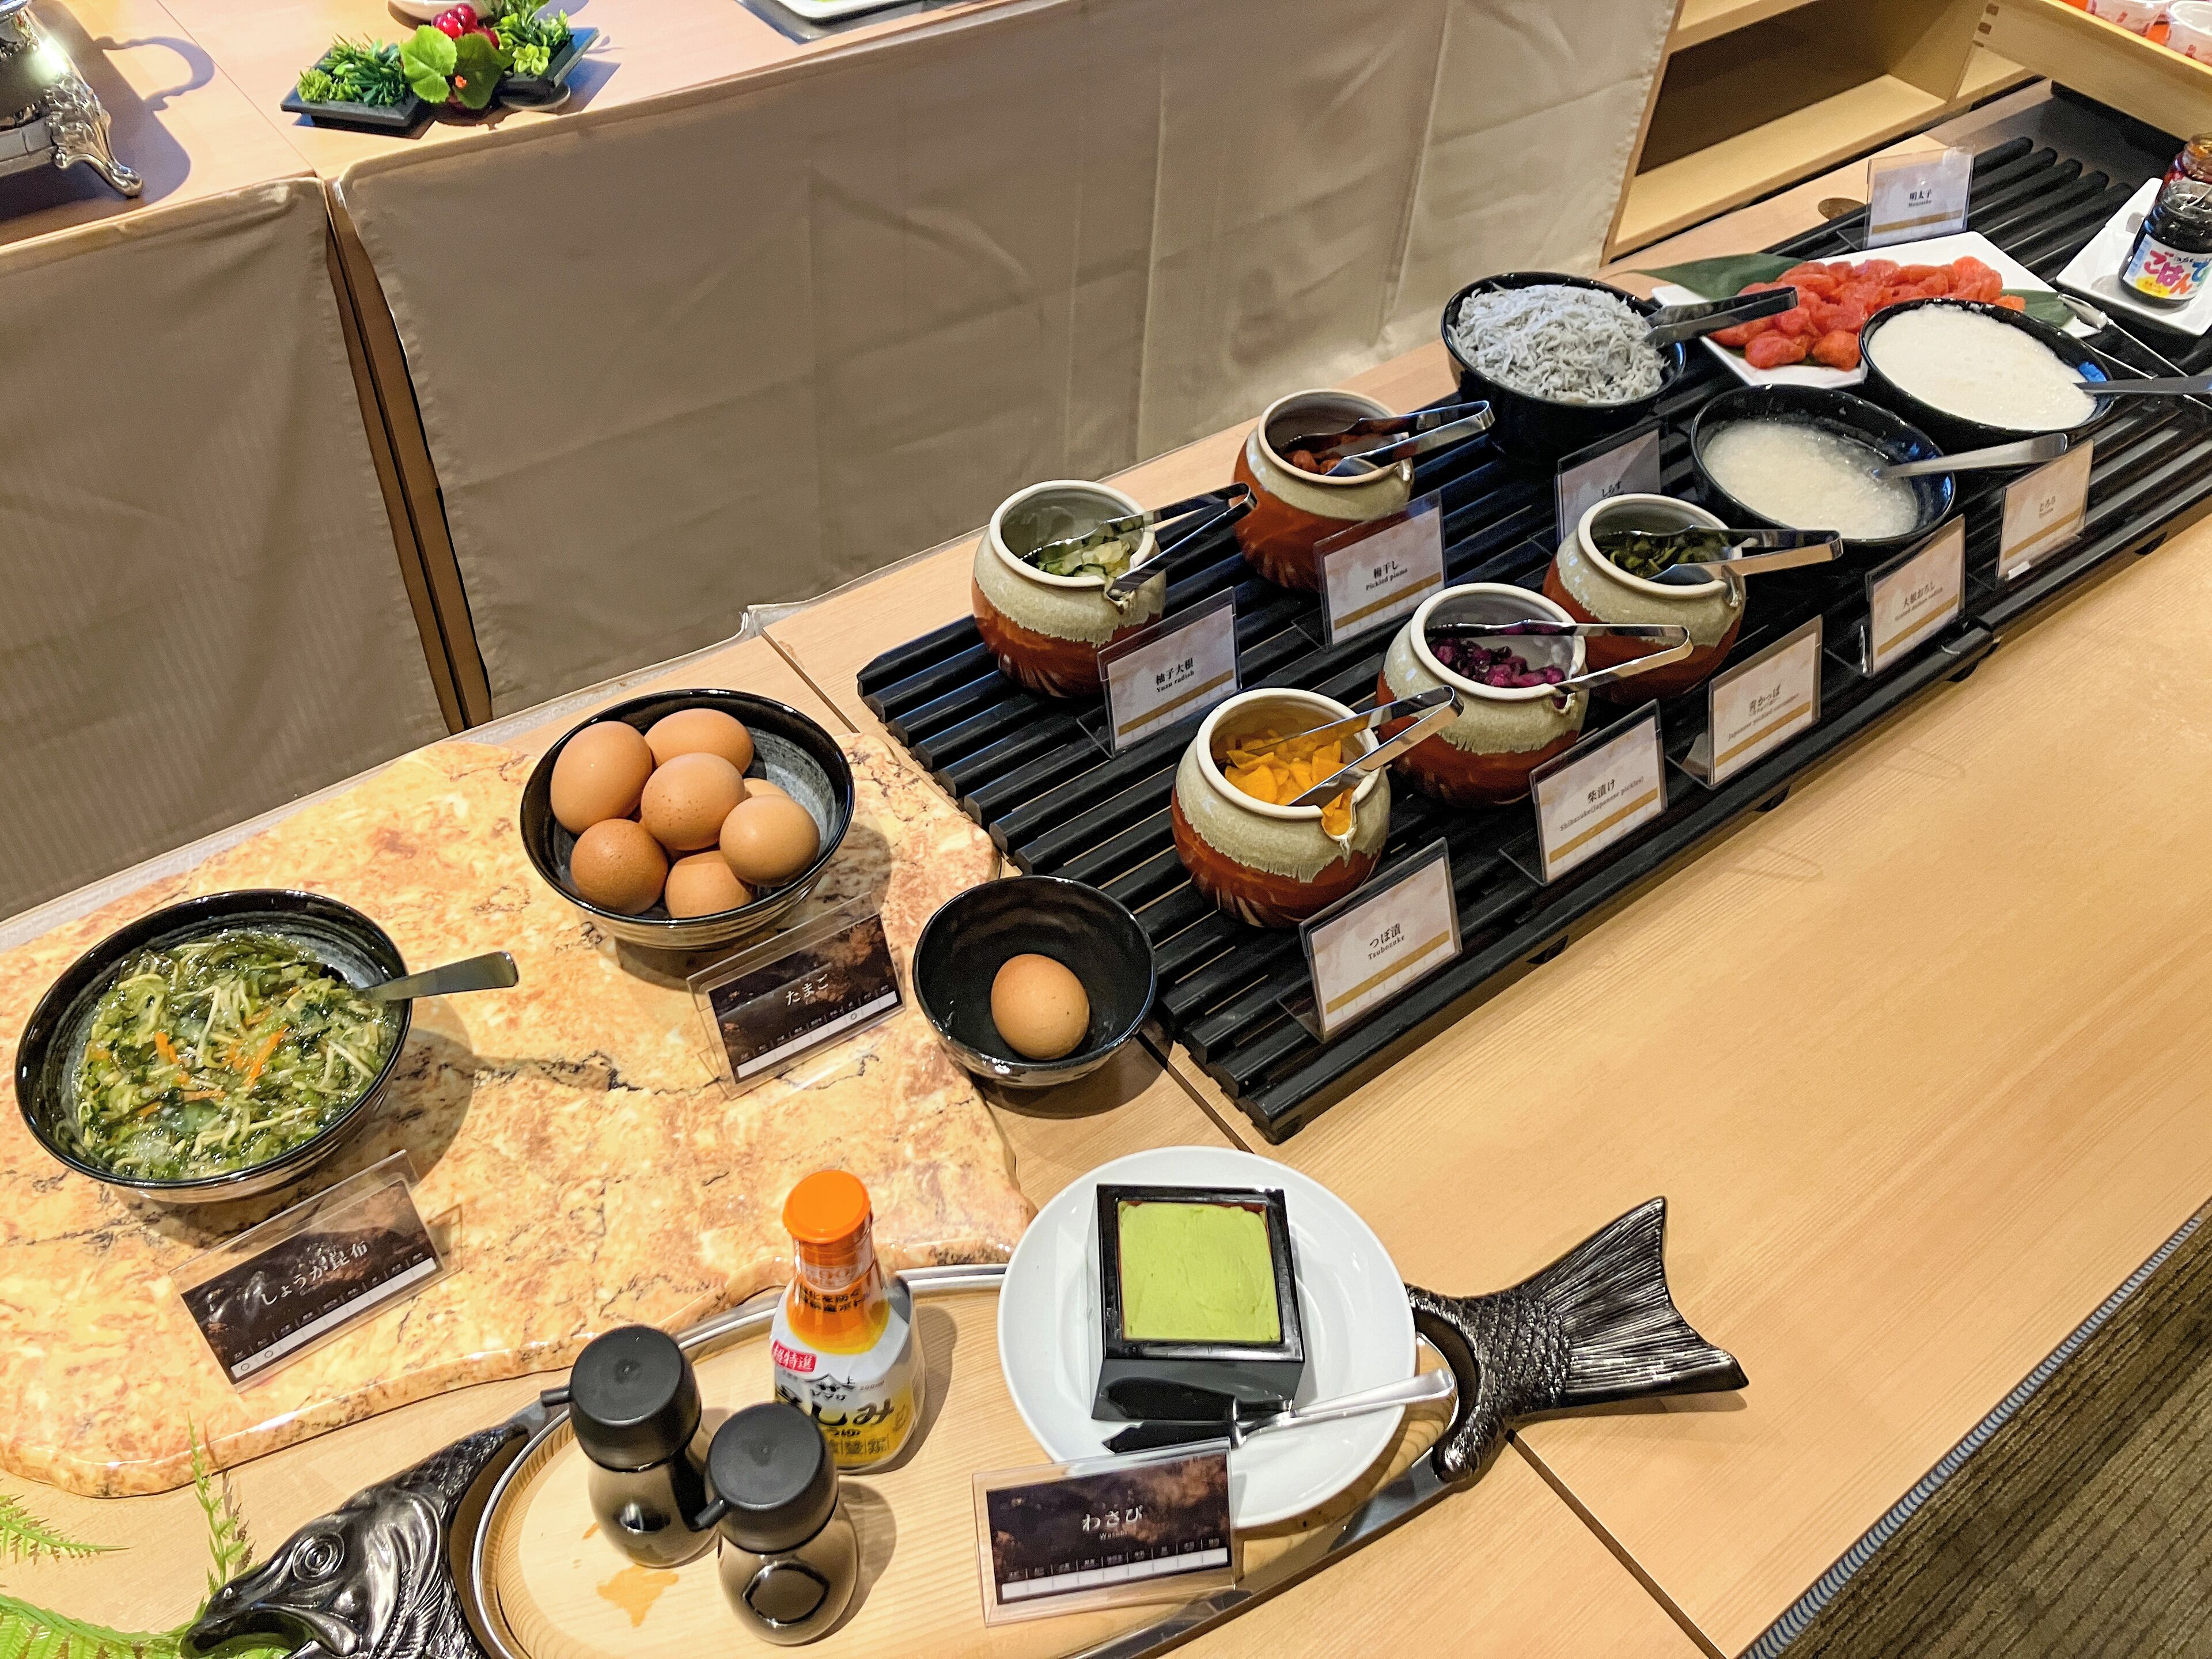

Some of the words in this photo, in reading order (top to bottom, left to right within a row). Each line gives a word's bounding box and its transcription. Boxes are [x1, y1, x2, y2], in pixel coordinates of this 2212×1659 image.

[1909, 189, 1931, 200] 明太子
[2144, 249, 2211, 295] ごはんで
[1156, 657, 1194, 685] 柚子大根
[1157, 682, 1172, 692] Yuzu
[1174, 669, 1194, 684] radish
[1588, 779, 1615, 803] 柴漬け
[1368, 935, 1404, 960] Tsubozuke
[1369, 922, 1401, 948] つぼ漬
[773, 1343, 813, 1370] 超特選
[1082, 1505, 1143, 1531] わさび
